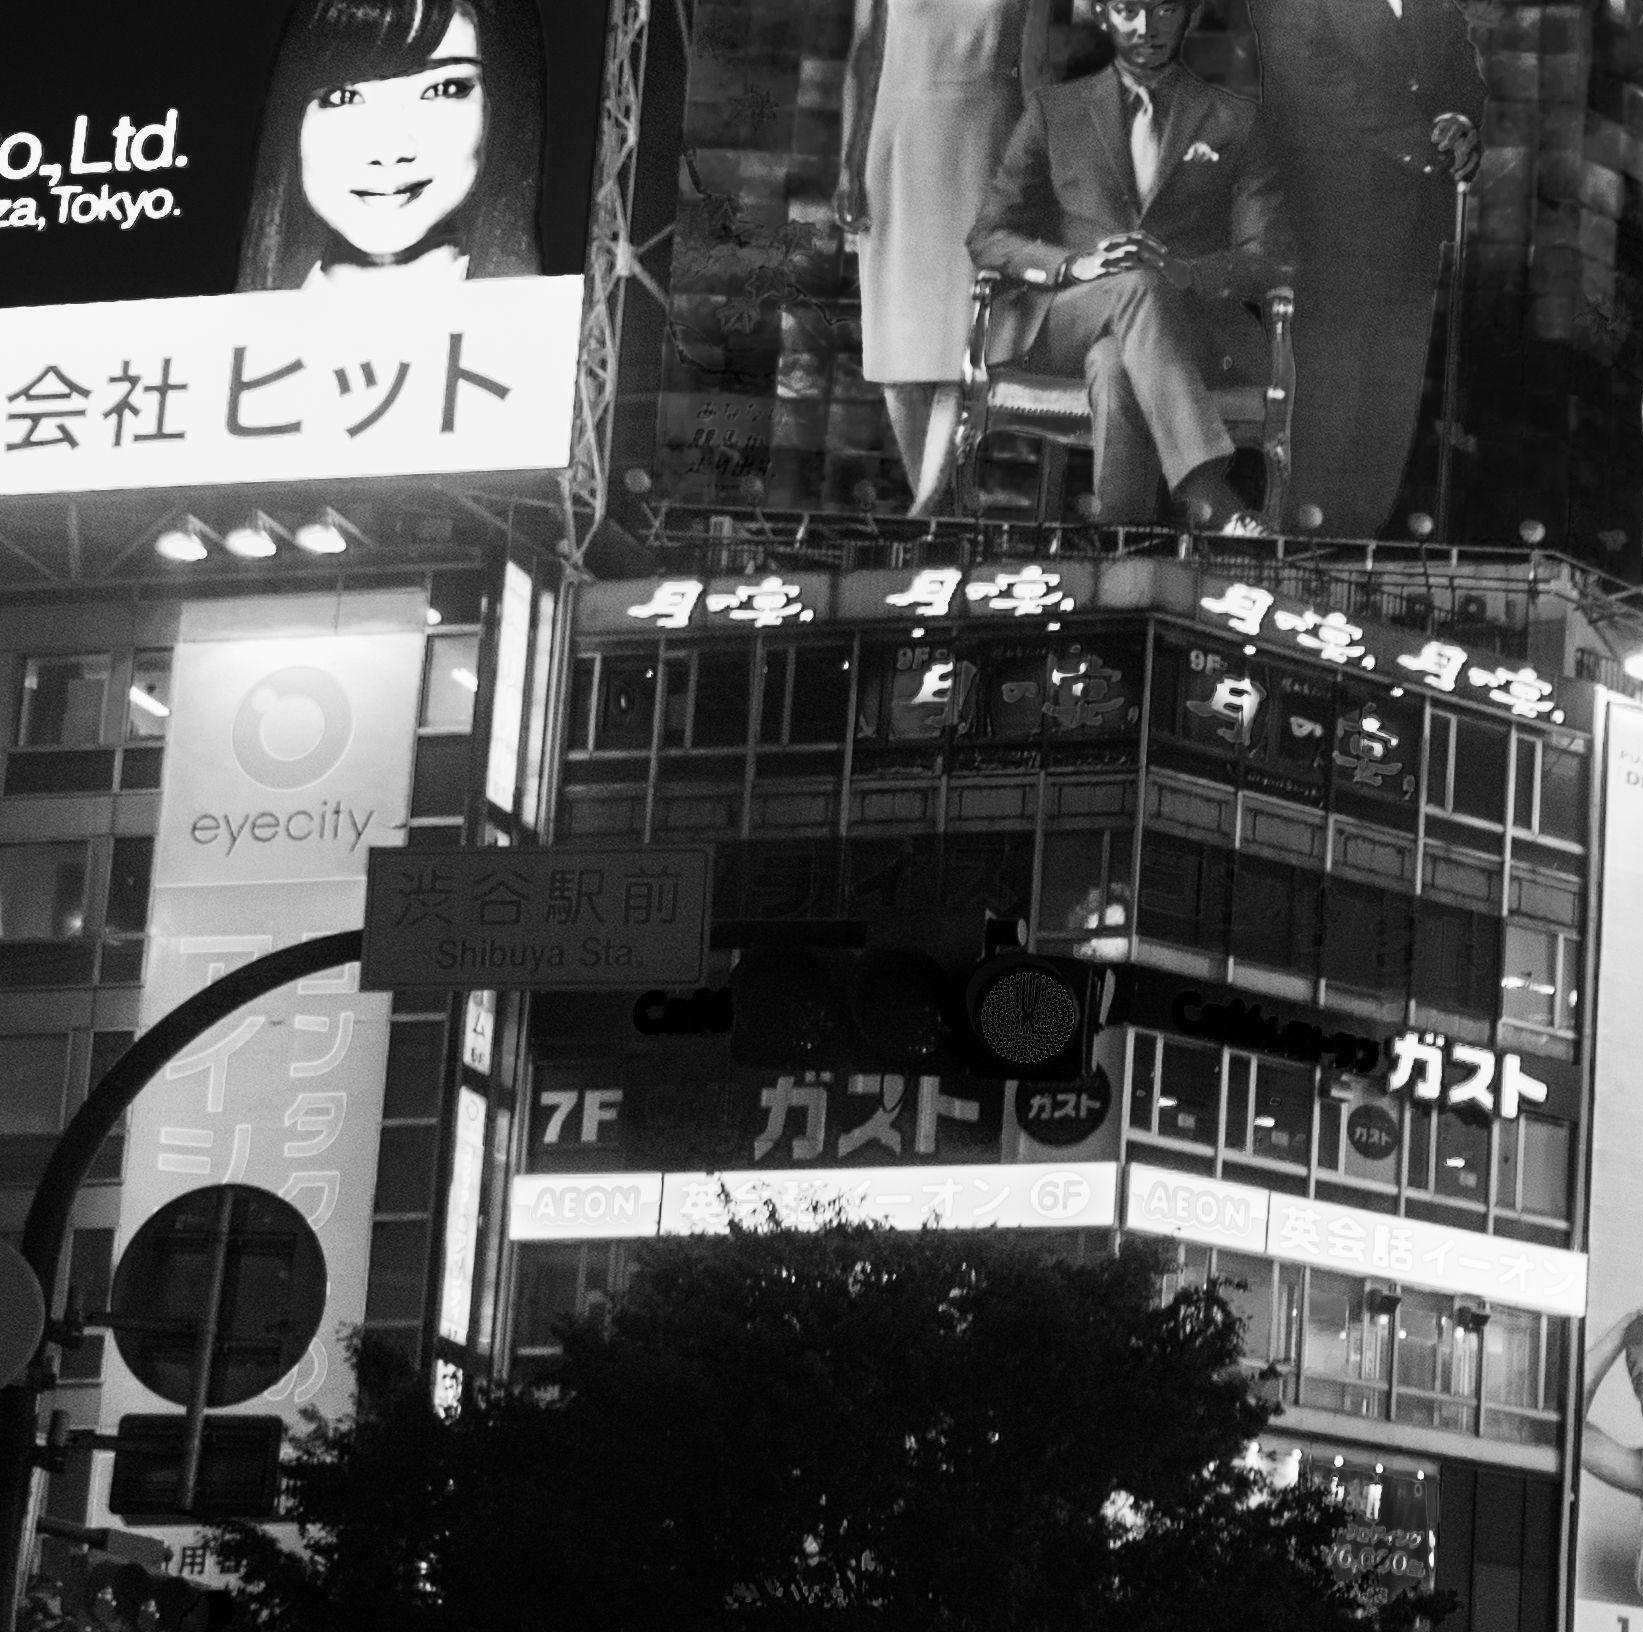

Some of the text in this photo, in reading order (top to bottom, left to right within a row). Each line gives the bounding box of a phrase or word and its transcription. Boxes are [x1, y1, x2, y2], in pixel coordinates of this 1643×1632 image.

[54, 184, 183, 231] Tokyo.
[190, 801, 374, 857] eyecity
[400, 868, 680, 926] 渋谷駅前
[435, 940, 644, 977] Shibuya Sta.
[1389, 1032, 1548, 1119] ガスト
[540, 1088, 624, 1144] 7F
[754, 1070, 979, 1161] ガスト
[1027, 1090, 1102, 1120] ガスト
[1354, 1124, 1393, 1147] ガスト
[536, 1187, 640, 1219] AEON
[1037, 1181, 1086, 1213] 6F
[1149, 1186, 1249, 1230] AEON
[1280, 1206, 1577, 1297] 英会話イーオン
